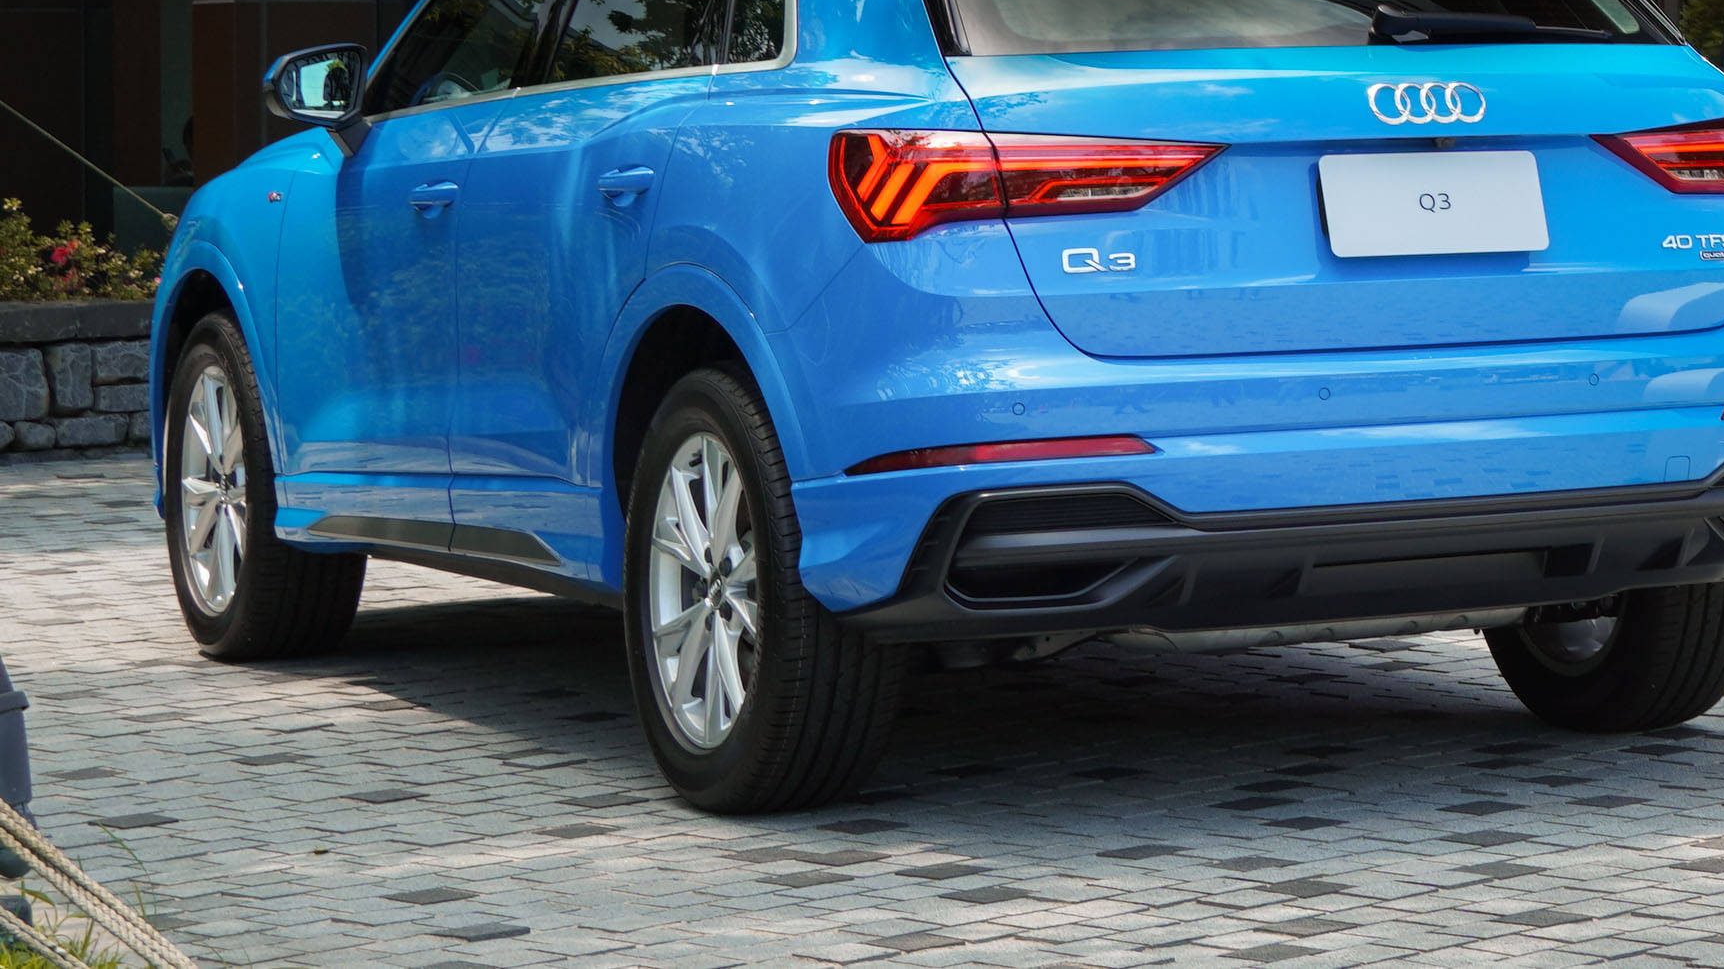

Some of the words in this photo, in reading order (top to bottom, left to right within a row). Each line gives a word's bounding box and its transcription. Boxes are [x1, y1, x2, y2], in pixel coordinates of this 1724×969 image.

[1419, 193, 1452, 213] Q3
[1662, 234, 1693, 249] 40
[1062, 247, 1136, 273] Q3
